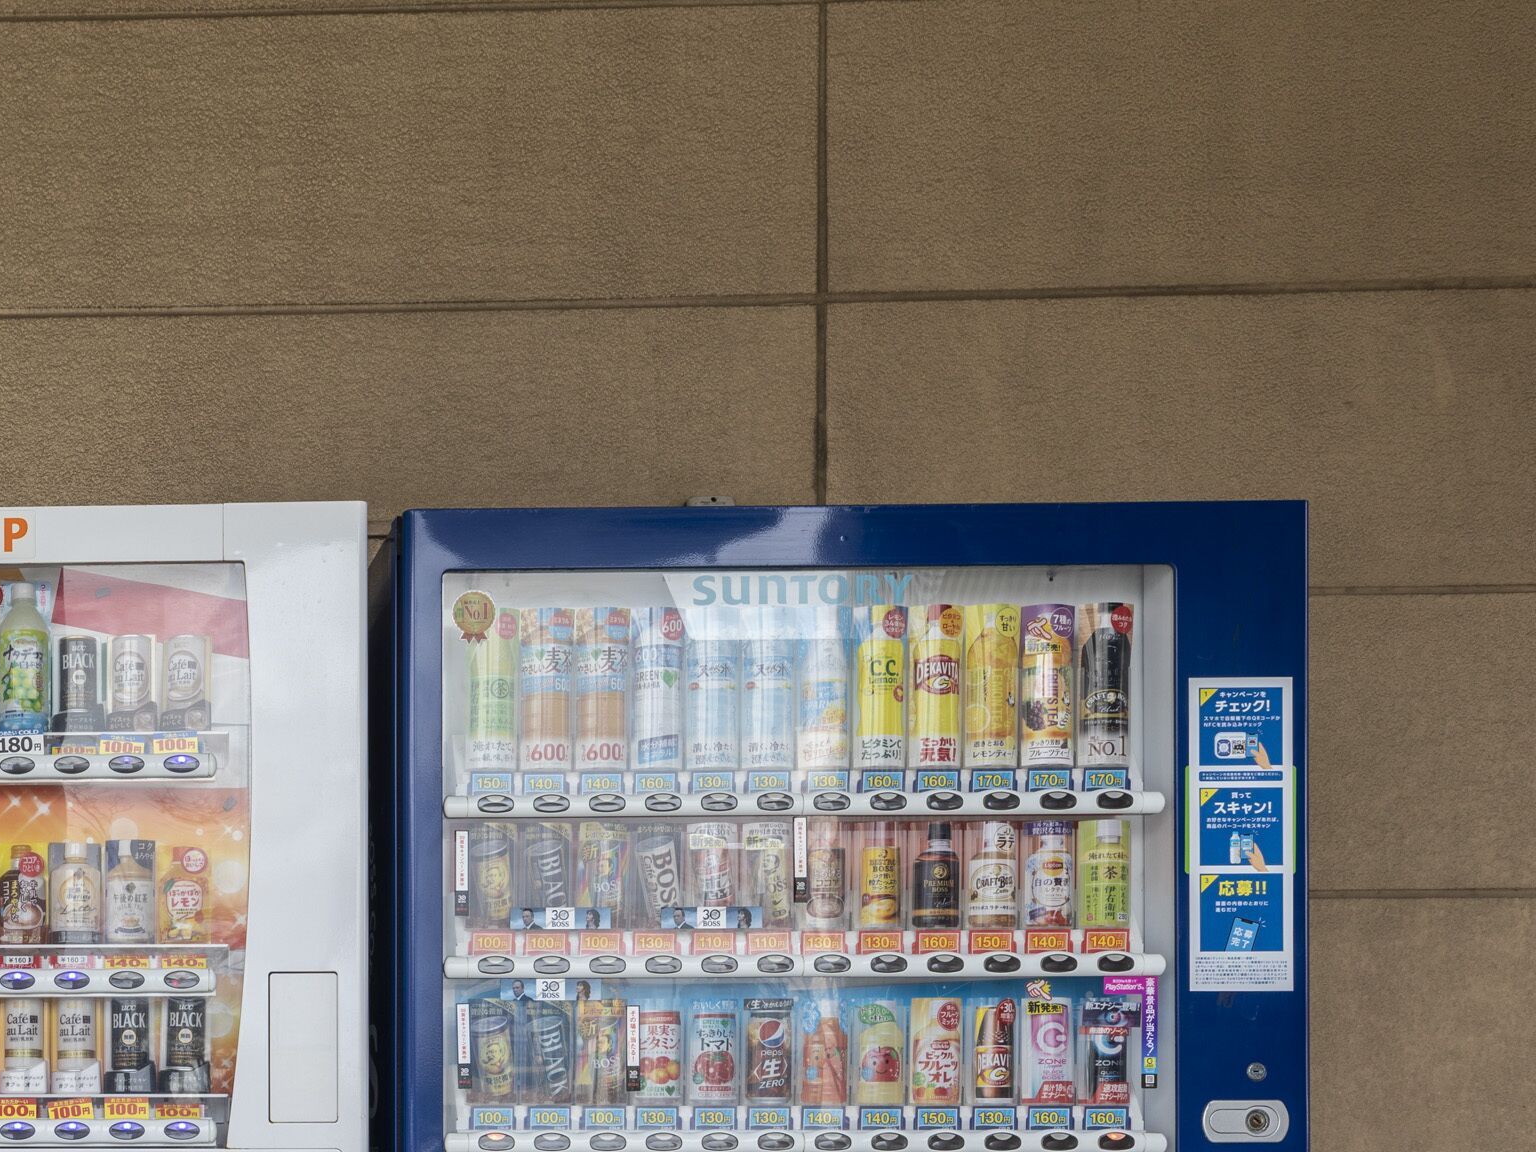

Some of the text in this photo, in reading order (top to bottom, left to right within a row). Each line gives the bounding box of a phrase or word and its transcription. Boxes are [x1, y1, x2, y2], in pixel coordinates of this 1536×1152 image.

[1002, 623, 1016, 632] 甘い
[63, 653, 94, 670] BLACK
[1215, 700, 1270, 712] チェック!
[155, 738, 195, 752] 100円
[1088, 736, 1127, 757] NO.1
[867, 775, 899, 788] 160円
[922, 775, 954, 787] 160円
[977, 775, 1009, 787] 170円
[1033, 774, 1065, 787] 170円
[1089, 774, 1121, 786] 170円
[1214, 801, 1272, 814] スキャン!
[1104, 866, 1118, 879] 茶
[1219, 880, 1267, 896] 応募!!
[476, 936, 508, 949] 100円
[531, 936, 562, 949] 100円
[584, 936, 616, 949] 100円
[639, 936, 671, 949] 130円
[865, 937, 897, 948] 130円
[923, 937, 954, 948] 160円
[976, 936, 1008, 948] 150円
[1032, 936, 1064, 948] 140円
[1090, 936, 1123, 948] 140円
[541, 991, 560, 999] BOSS
[7, 1013, 28, 1025] Café
[59, 1013, 81, 1025] Café
[113, 1013, 146, 1028] BLACK
[170, 1012, 202, 1027] BLACK
[19, 1025, 38, 1036] Lait
[72, 1025, 91, 1036] Lait
[699, 1038, 733, 1051] トマト
[919, 1061, 958, 1071] フルーツ
[759, 1078, 785, 1089] ZERO
[928, 1072, 952, 1083] オレ
[52, 1106, 91, 1118] 100円
[108, 1103, 146, 1115] 100円
[807, 1113, 840, 1124] 140円
[865, 1113, 897, 1124] 140円
[922, 1113, 954, 1124] 150円
[978, 1112, 1011, 1124] 130円
[1034, 1112, 1066, 1124] 160円
[1091, 1112, 1123, 1124] 160円
